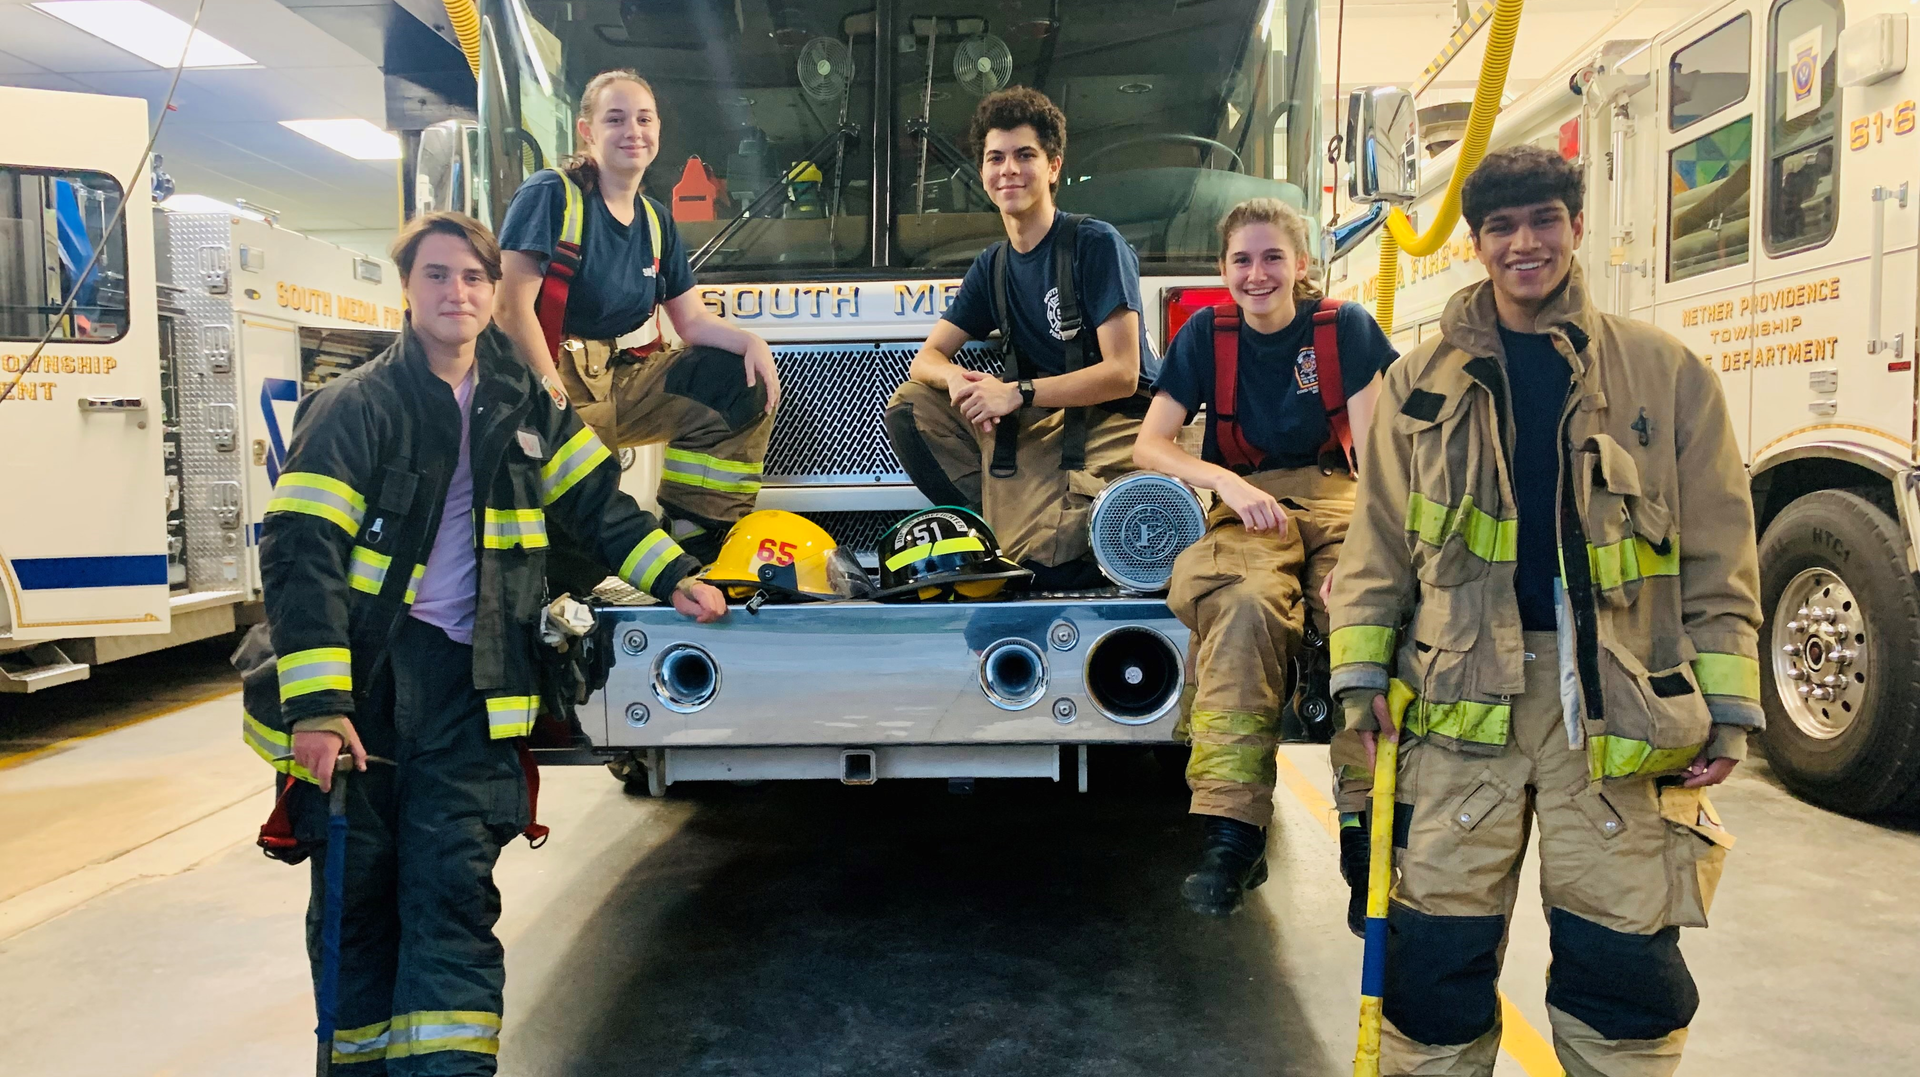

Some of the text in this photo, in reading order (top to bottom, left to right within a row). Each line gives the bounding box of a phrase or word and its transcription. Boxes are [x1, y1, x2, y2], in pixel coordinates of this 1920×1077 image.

[1362, 263, 1405, 304] MEA
[276, 281, 333, 317] SOUTH
[336, 295, 380, 327] MEDIA
[699, 286, 860, 319] SOUTH
[1682, 277, 1841, 328] NETHER PROVIDENCE
[1710, 315, 1803, 345] TOWNSHIP
[1721, 336, 1838, 372] DEPARTMENT
[912, 521, 943, 546] 51
[756, 538, 798, 567] 65
